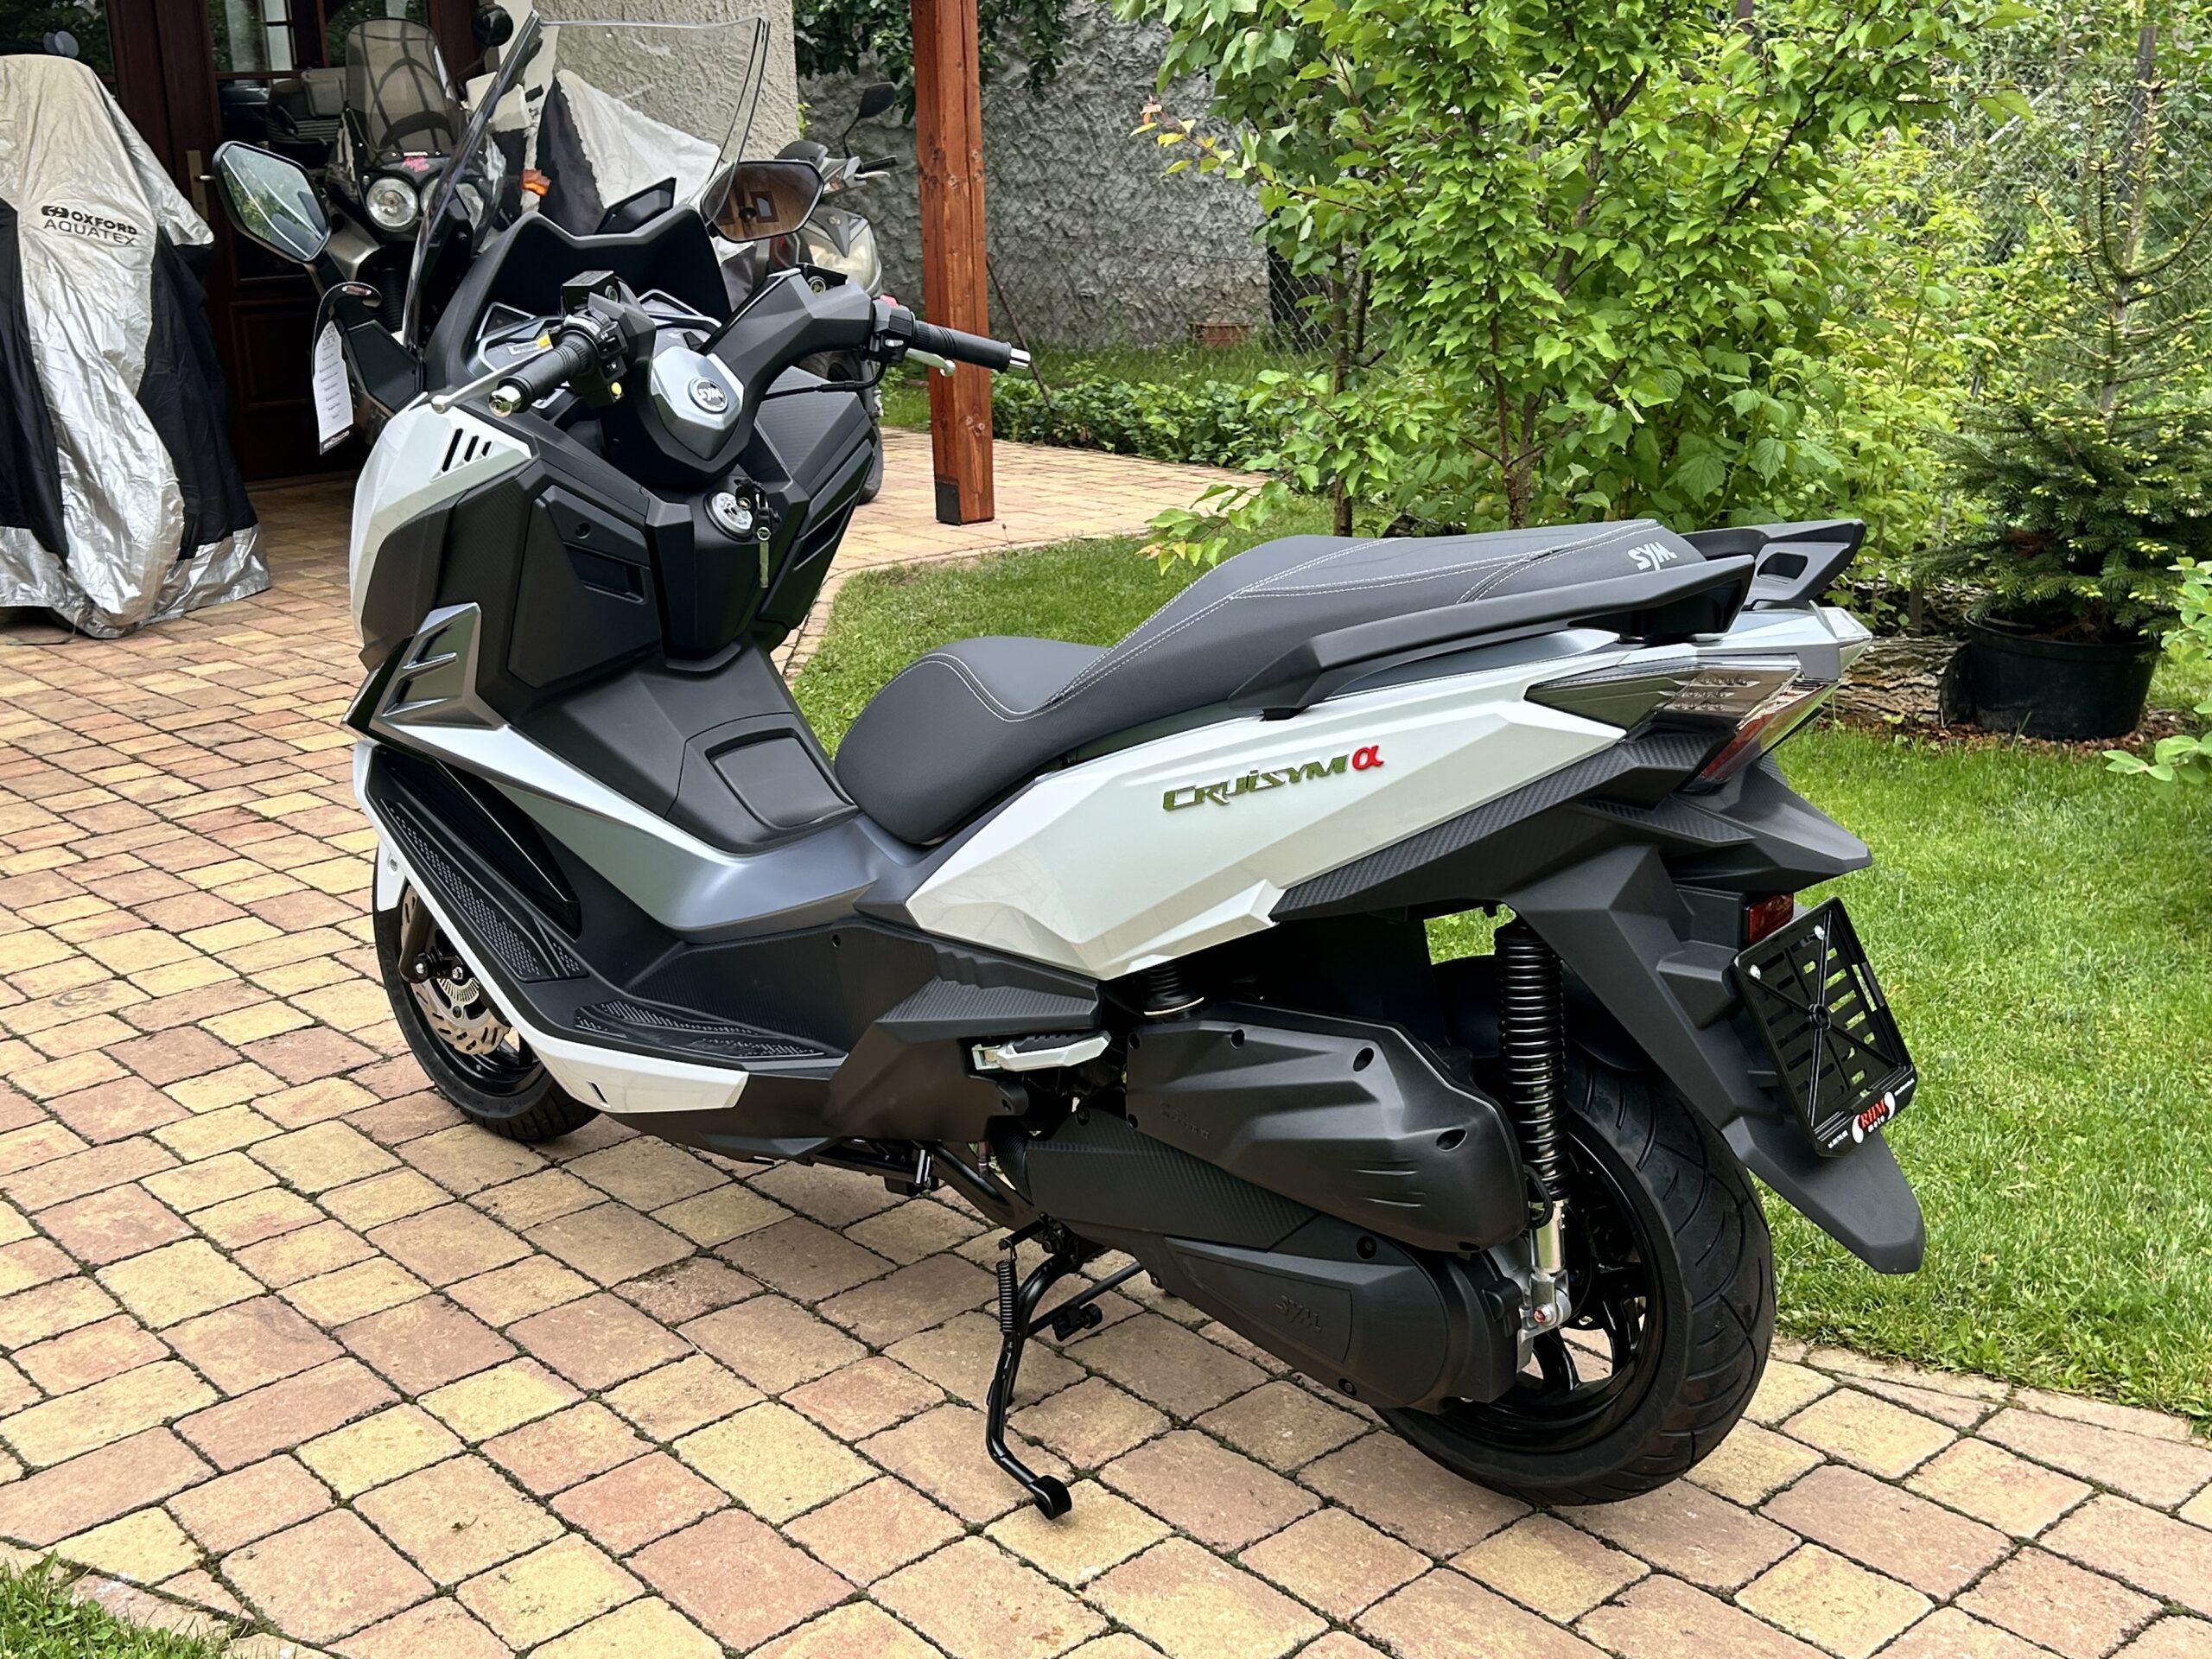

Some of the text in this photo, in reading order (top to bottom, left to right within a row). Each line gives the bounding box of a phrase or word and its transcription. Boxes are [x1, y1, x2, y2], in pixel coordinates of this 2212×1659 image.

[43, 219, 136, 246] AQUATEX
[72, 211, 137, 235] OXFORD
[698, 388, 724, 402] SYM
[1627, 541, 1677, 571] SYM
